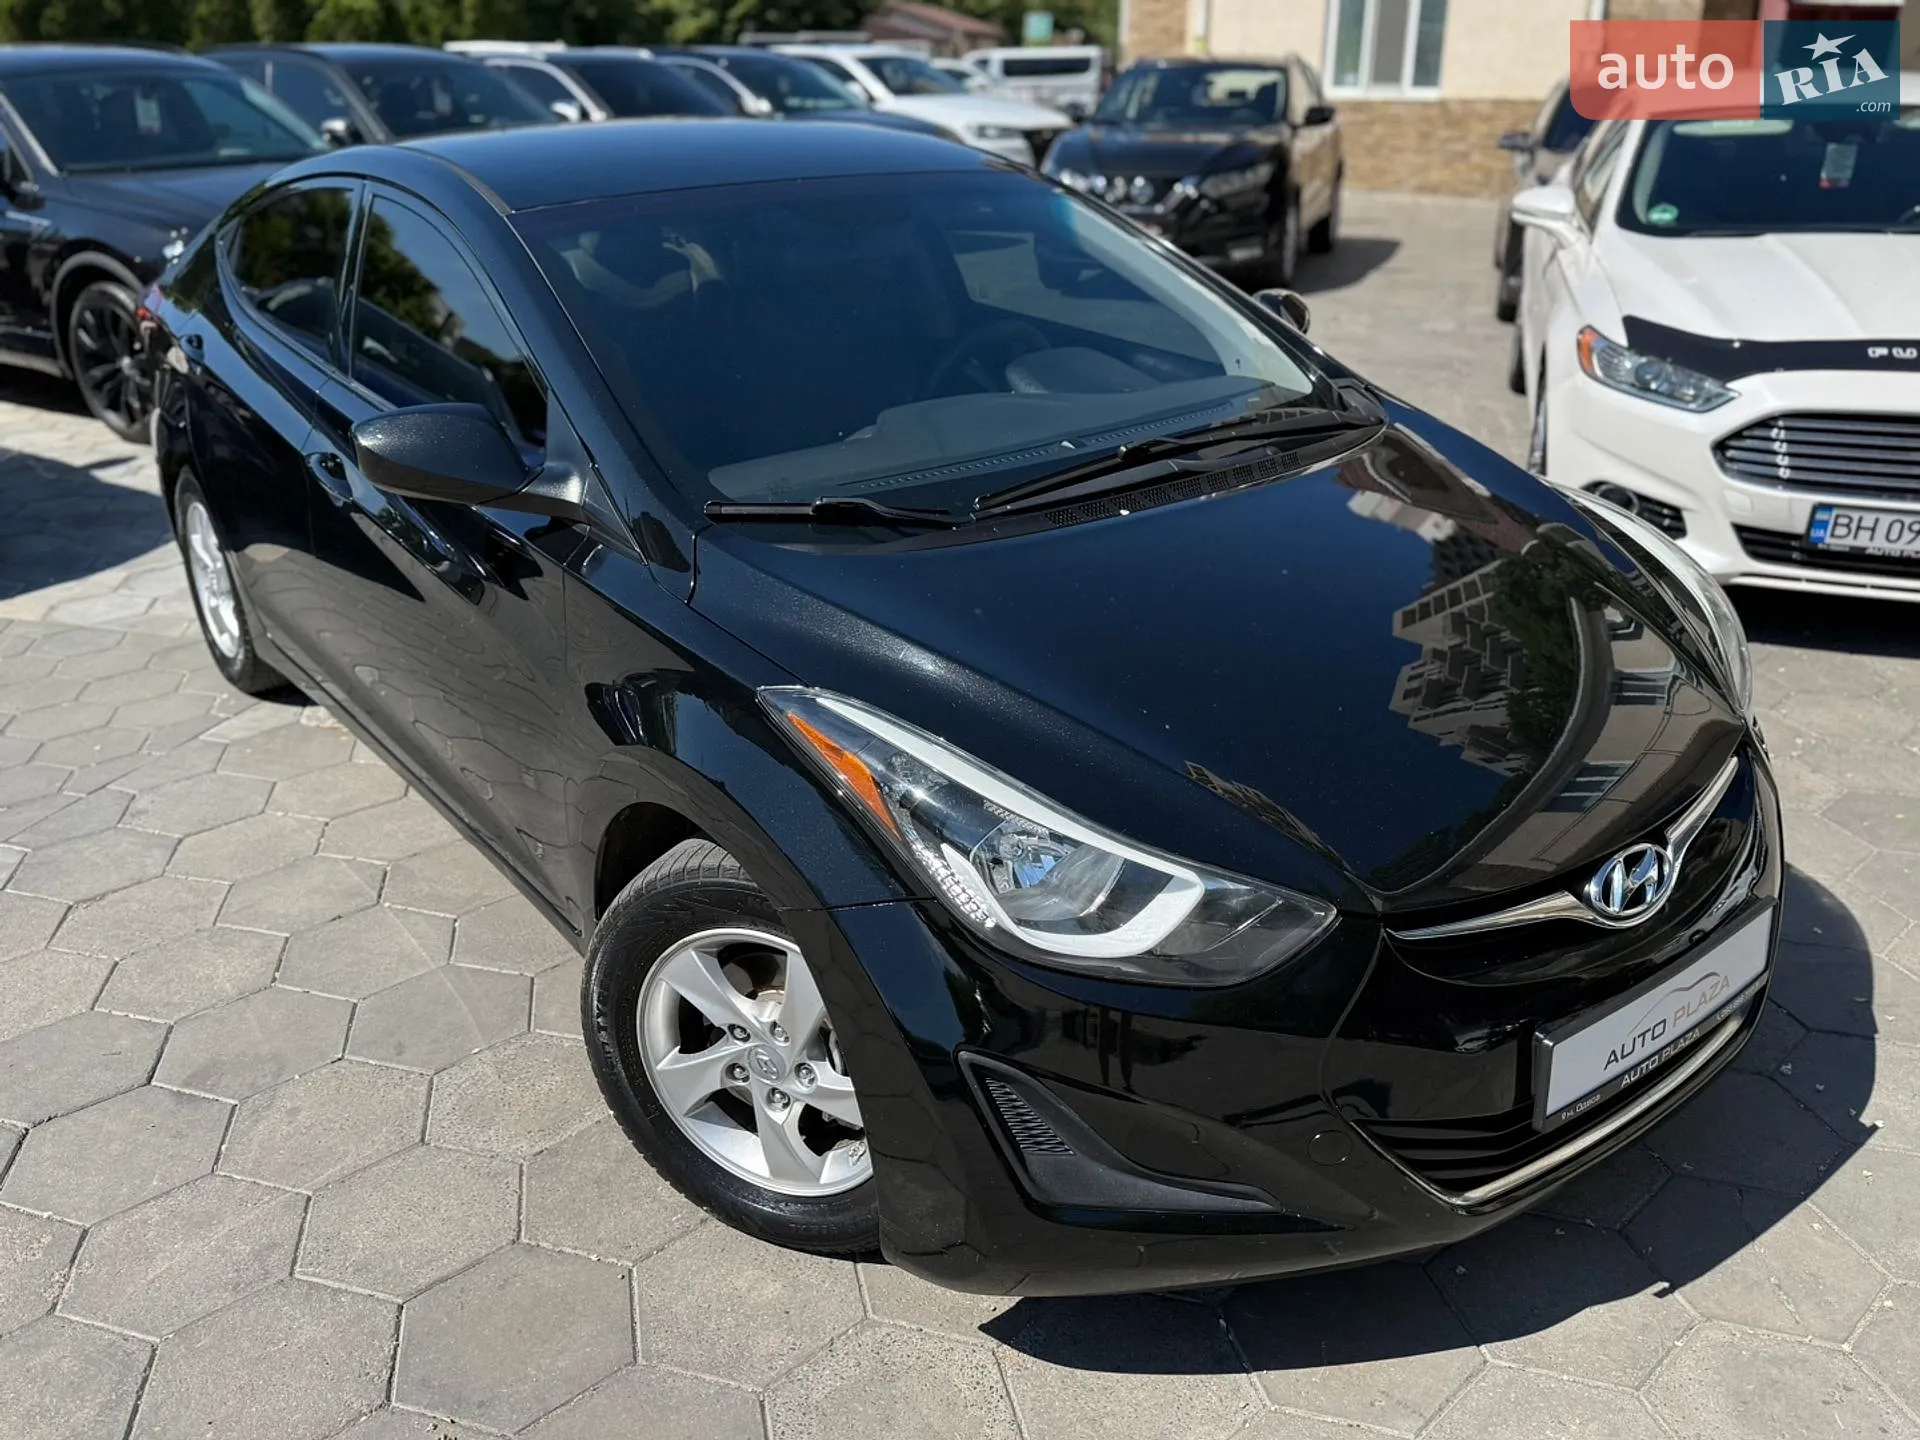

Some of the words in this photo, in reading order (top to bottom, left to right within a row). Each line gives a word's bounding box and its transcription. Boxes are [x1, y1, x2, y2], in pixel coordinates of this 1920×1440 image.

[1830, 514, 1881, 542] BH
[1885, 518, 1920, 546] 09
[1603, 1018, 1667, 1071] AUTO
[1673, 975, 1730, 1028] PLAZA
[1621, 1055, 1660, 1088] AUTO
[1661, 1028, 1701, 1062] PLAZA
